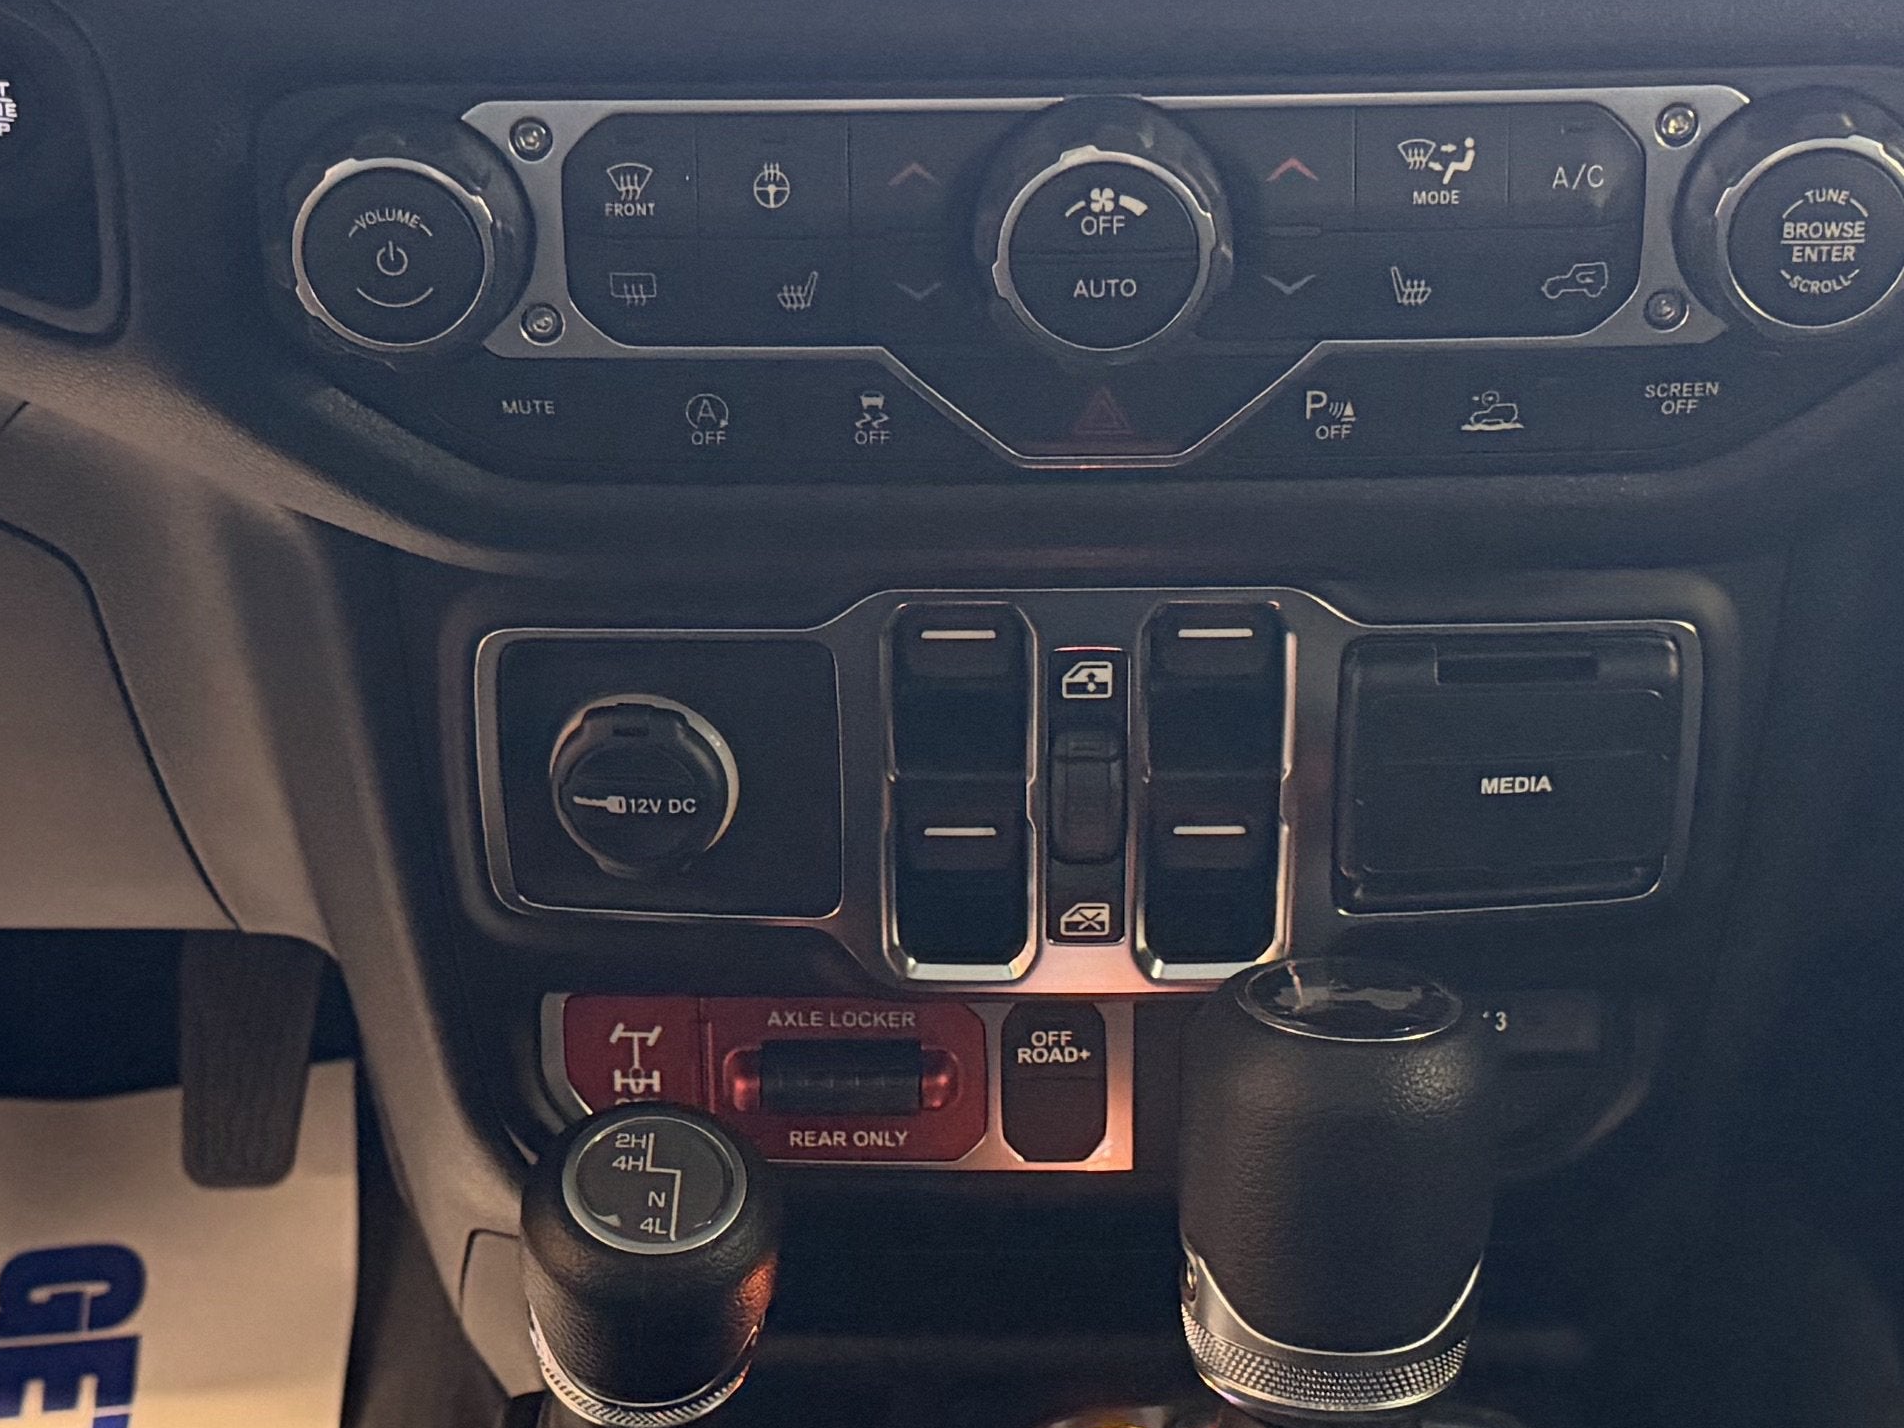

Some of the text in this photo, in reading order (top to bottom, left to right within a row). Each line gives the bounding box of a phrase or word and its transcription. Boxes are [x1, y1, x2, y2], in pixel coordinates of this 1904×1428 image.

[1552, 164, 1605, 191] A/C
[1412, 190, 1460, 205] MODE
[1804, 188, 1851, 206] TUNE
[604, 202, 656, 218] FRONT
[354, 210, 422, 230] VOLUME
[1080, 215, 1126, 236] OFF
[1782, 221, 1866, 239] BROWSE
[1791, 245, 1856, 263] ENTER
[1072, 278, 1137, 299] AUTO
[1788, 272, 1853, 294] SCROLL
[1644, 382, 1720, 399] SCREEN
[502, 399, 555, 416] MUTE
[1661, 399, 1699, 415] OFF
[690, 430, 727, 446] OFF
[854, 430, 891, 446] OFF
[1315, 425, 1352, 440] OFF
[1481, 776, 1552, 795] MEDIA
[628, 798, 697, 814] 12V DC
[767, 1011, 916, 1028] AXLE LOCKER
[1031, 1030, 1073, 1047] OFF
[1017, 1046, 1091, 1064] ROAD+
[615, 1132, 646, 1149] 2H
[789, 1130, 908, 1147] REAR ONLY
[612, 1156, 644, 1171] 4H
[648, 1191, 666, 1208] N
[639, 1217, 667, 1234] 4L
